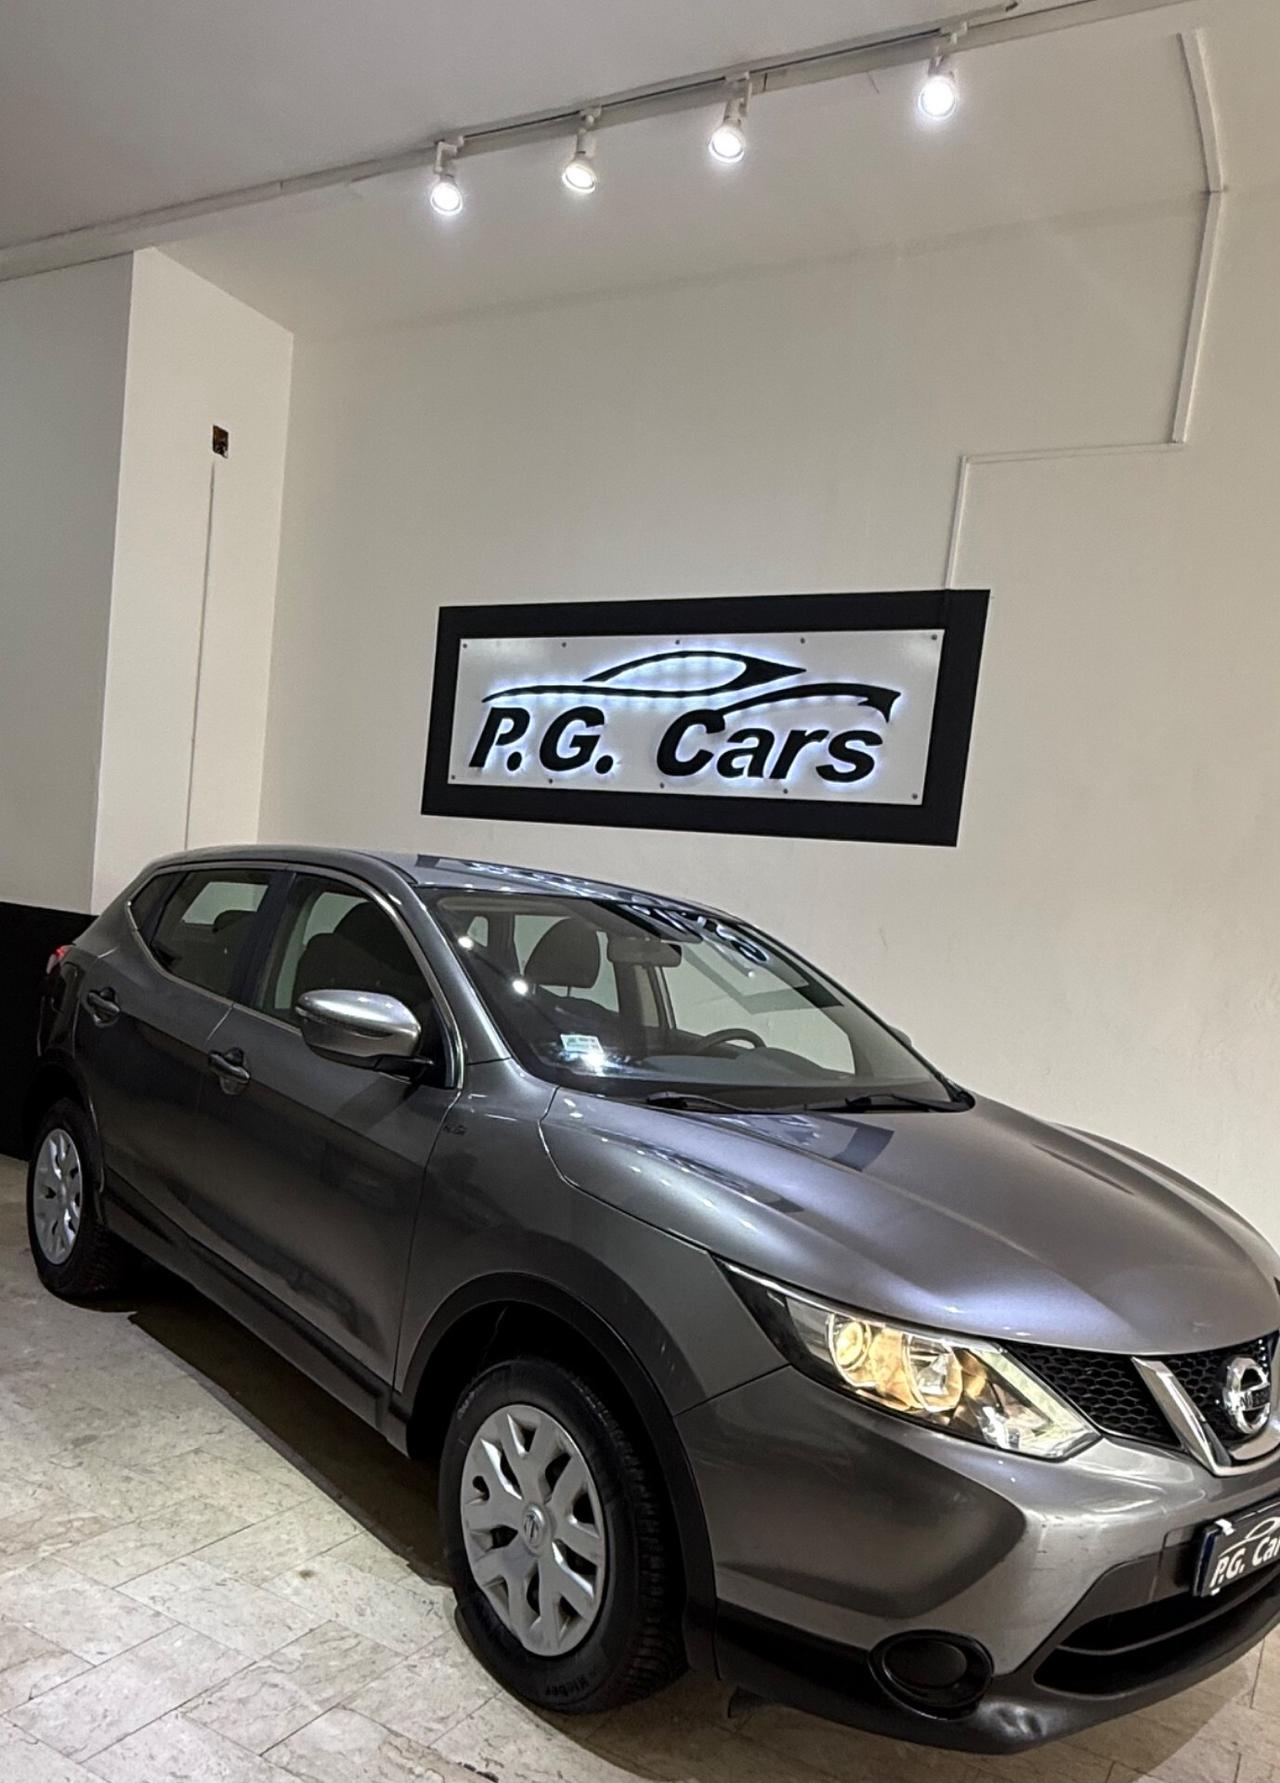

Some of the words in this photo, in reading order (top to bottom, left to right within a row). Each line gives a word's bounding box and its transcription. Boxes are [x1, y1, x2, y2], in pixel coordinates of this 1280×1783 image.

[468, 706, 614, 774] P.G.
[656, 708, 883, 783] Cars
[1209, 1547, 1246, 1588] P.G.
